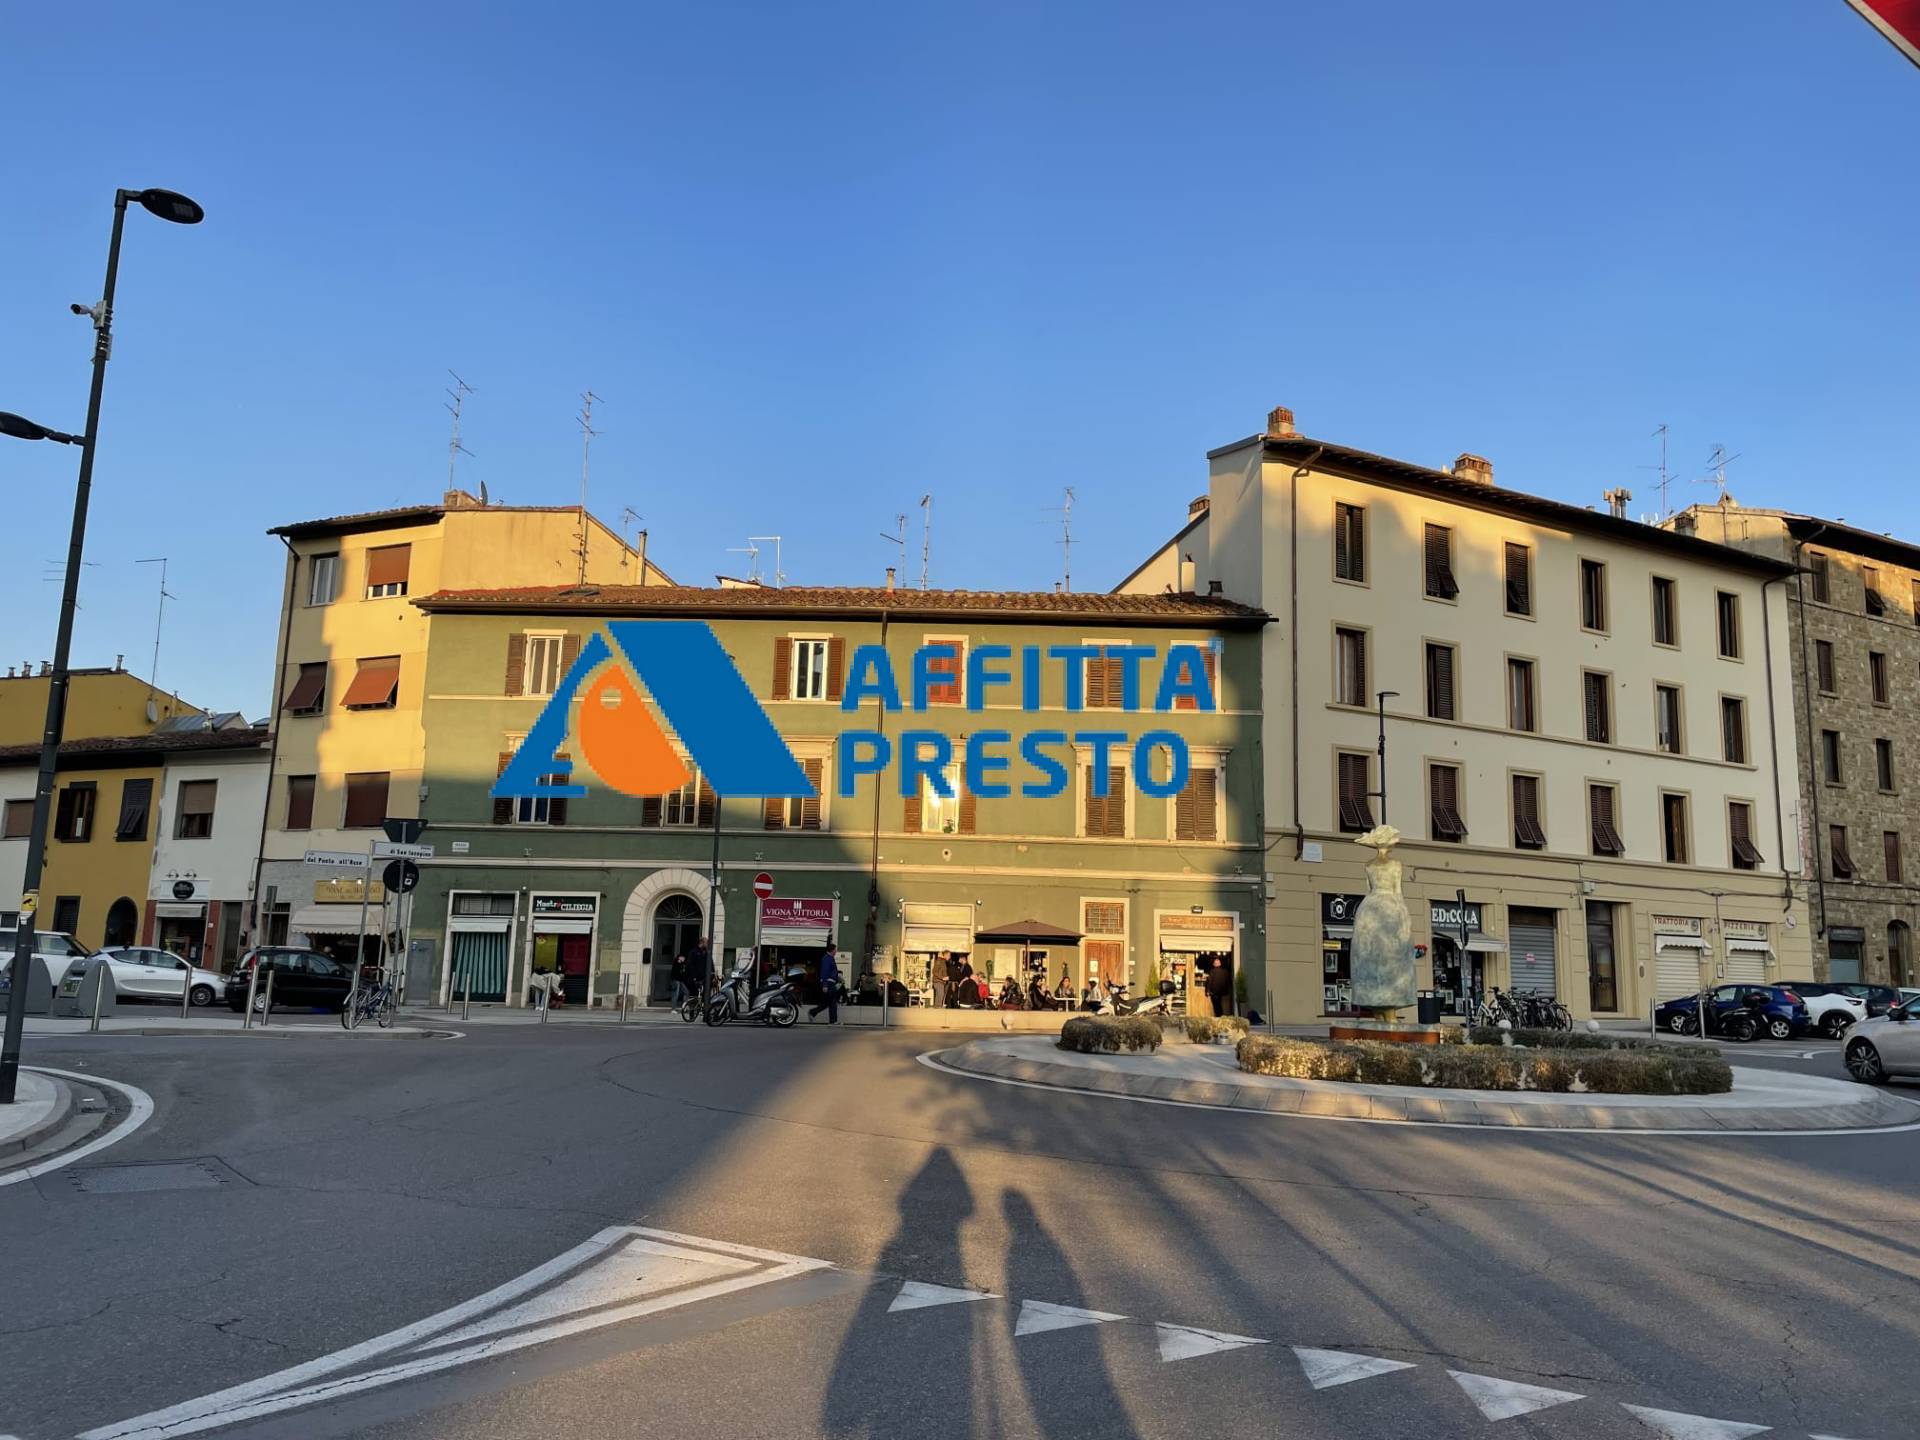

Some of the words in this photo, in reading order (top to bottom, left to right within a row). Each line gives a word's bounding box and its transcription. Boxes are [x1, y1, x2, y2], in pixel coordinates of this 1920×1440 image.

[766, 908, 792, 916] VIGNA
[792, 908, 830, 917] VITTORIA
[1654, 917, 1689, 926] TRATTORIA
